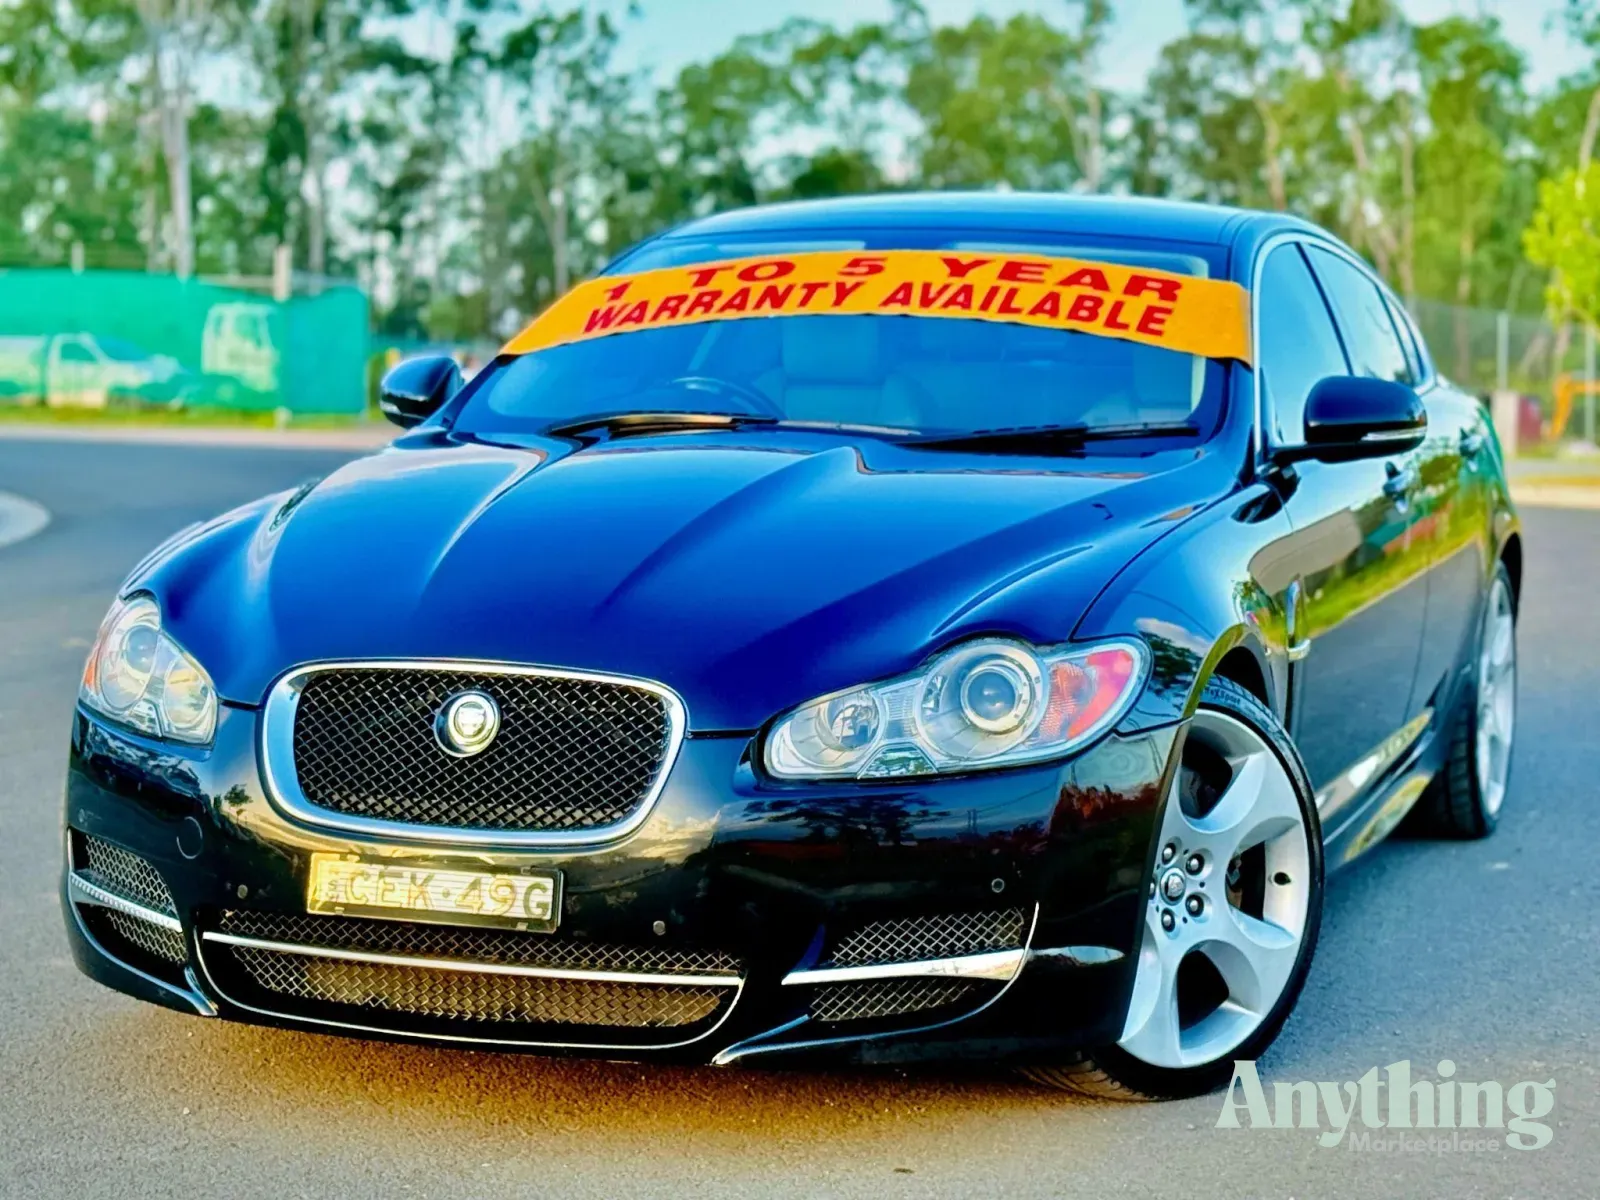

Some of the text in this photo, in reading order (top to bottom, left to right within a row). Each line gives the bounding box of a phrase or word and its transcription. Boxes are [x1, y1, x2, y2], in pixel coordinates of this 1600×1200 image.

[605, 257, 1184, 303] 1 TO 5 YEAR
[582, 280, 1175, 337] WARRANTY AVAILABLE
